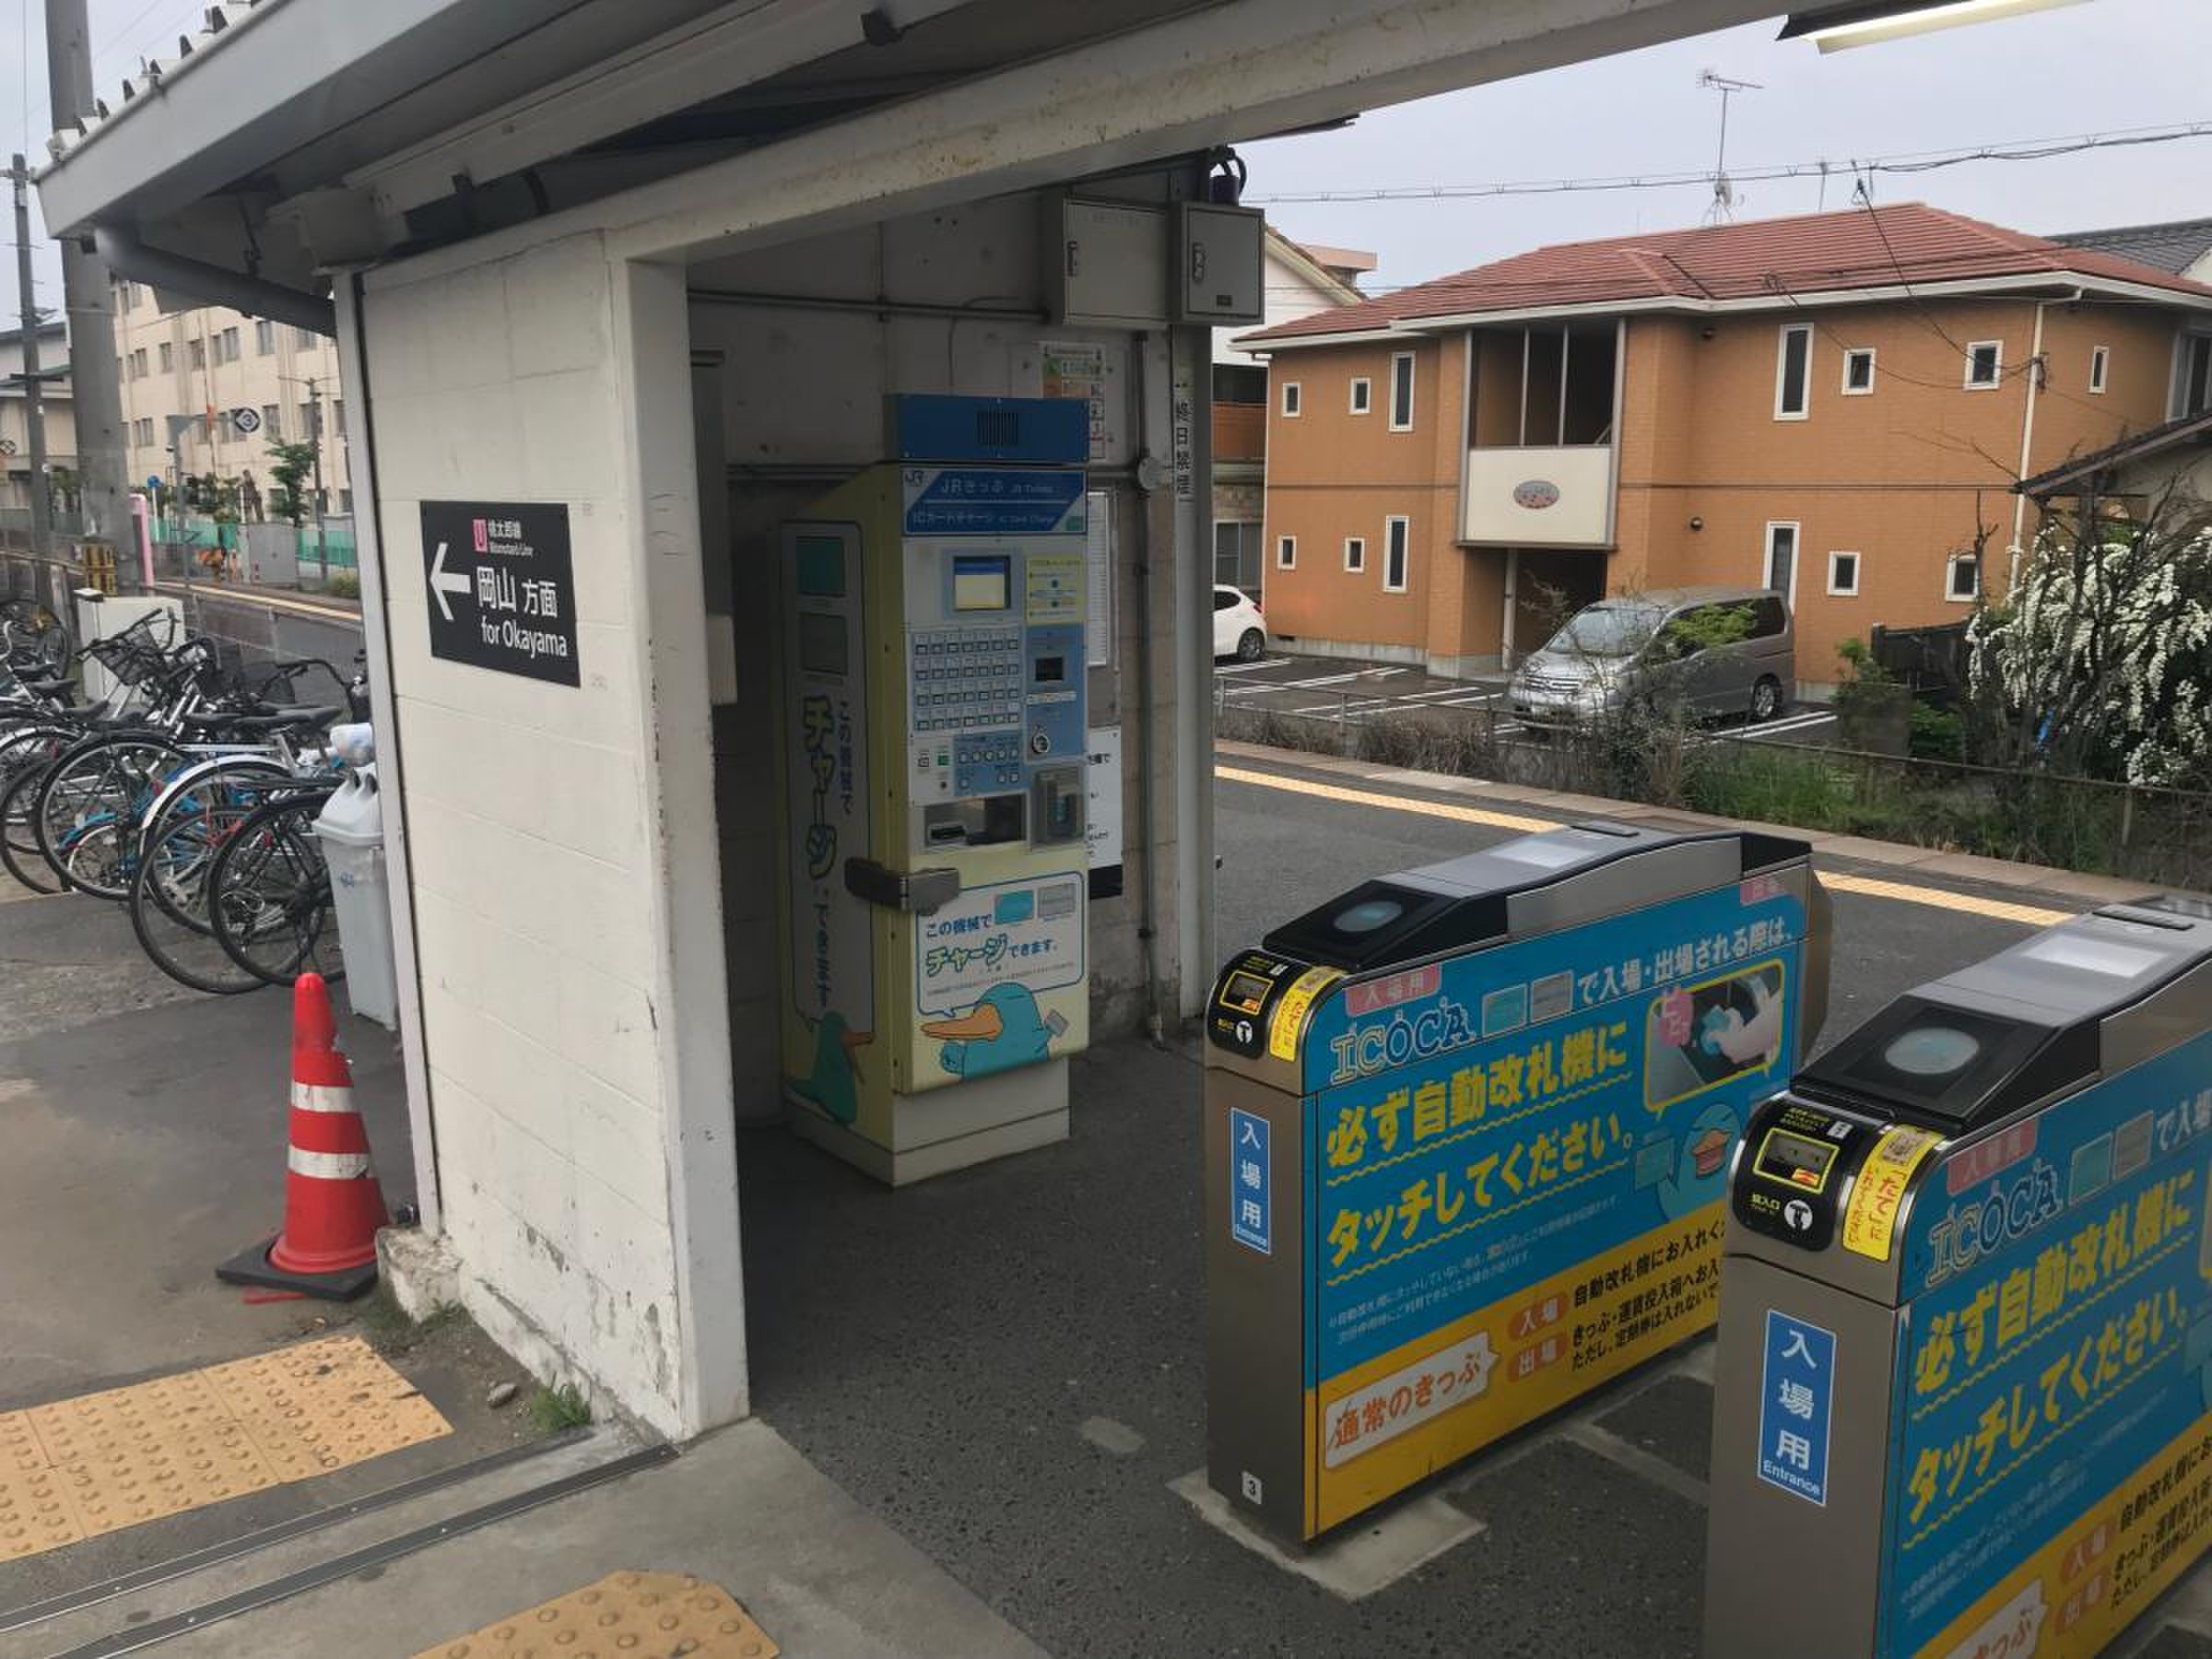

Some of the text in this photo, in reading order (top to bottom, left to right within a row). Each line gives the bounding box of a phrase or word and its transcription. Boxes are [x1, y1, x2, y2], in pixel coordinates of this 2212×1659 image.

[477, 565, 559, 618] 岡山 方面
[481, 615, 568, 659] for Okayama
[926, 913, 993, 938] この機械で
[1328, 995, 1477, 1085] ICOCA
[1326, 1020, 1628, 1167] 必ず自動改札機に
[1240, 1121, 1262, 1230] 入場用
[1327, 1113, 1633, 1267] タッチしてください。
[1925, 1158, 2064, 1288] ICOCA
[1520, 1297, 1559, 1335] 入場
[1915, 1168, 2195, 1395] 必ず自動改札機に
[1517, 1337, 1558, 1374] 出場
[1775, 1328, 1818, 1470] 入場用
[1328, 1352, 1482, 1450] 通常のきっぷ
[1248, 1479, 1256, 1497] 3
[1762, 1457, 1821, 1498] Entrance
